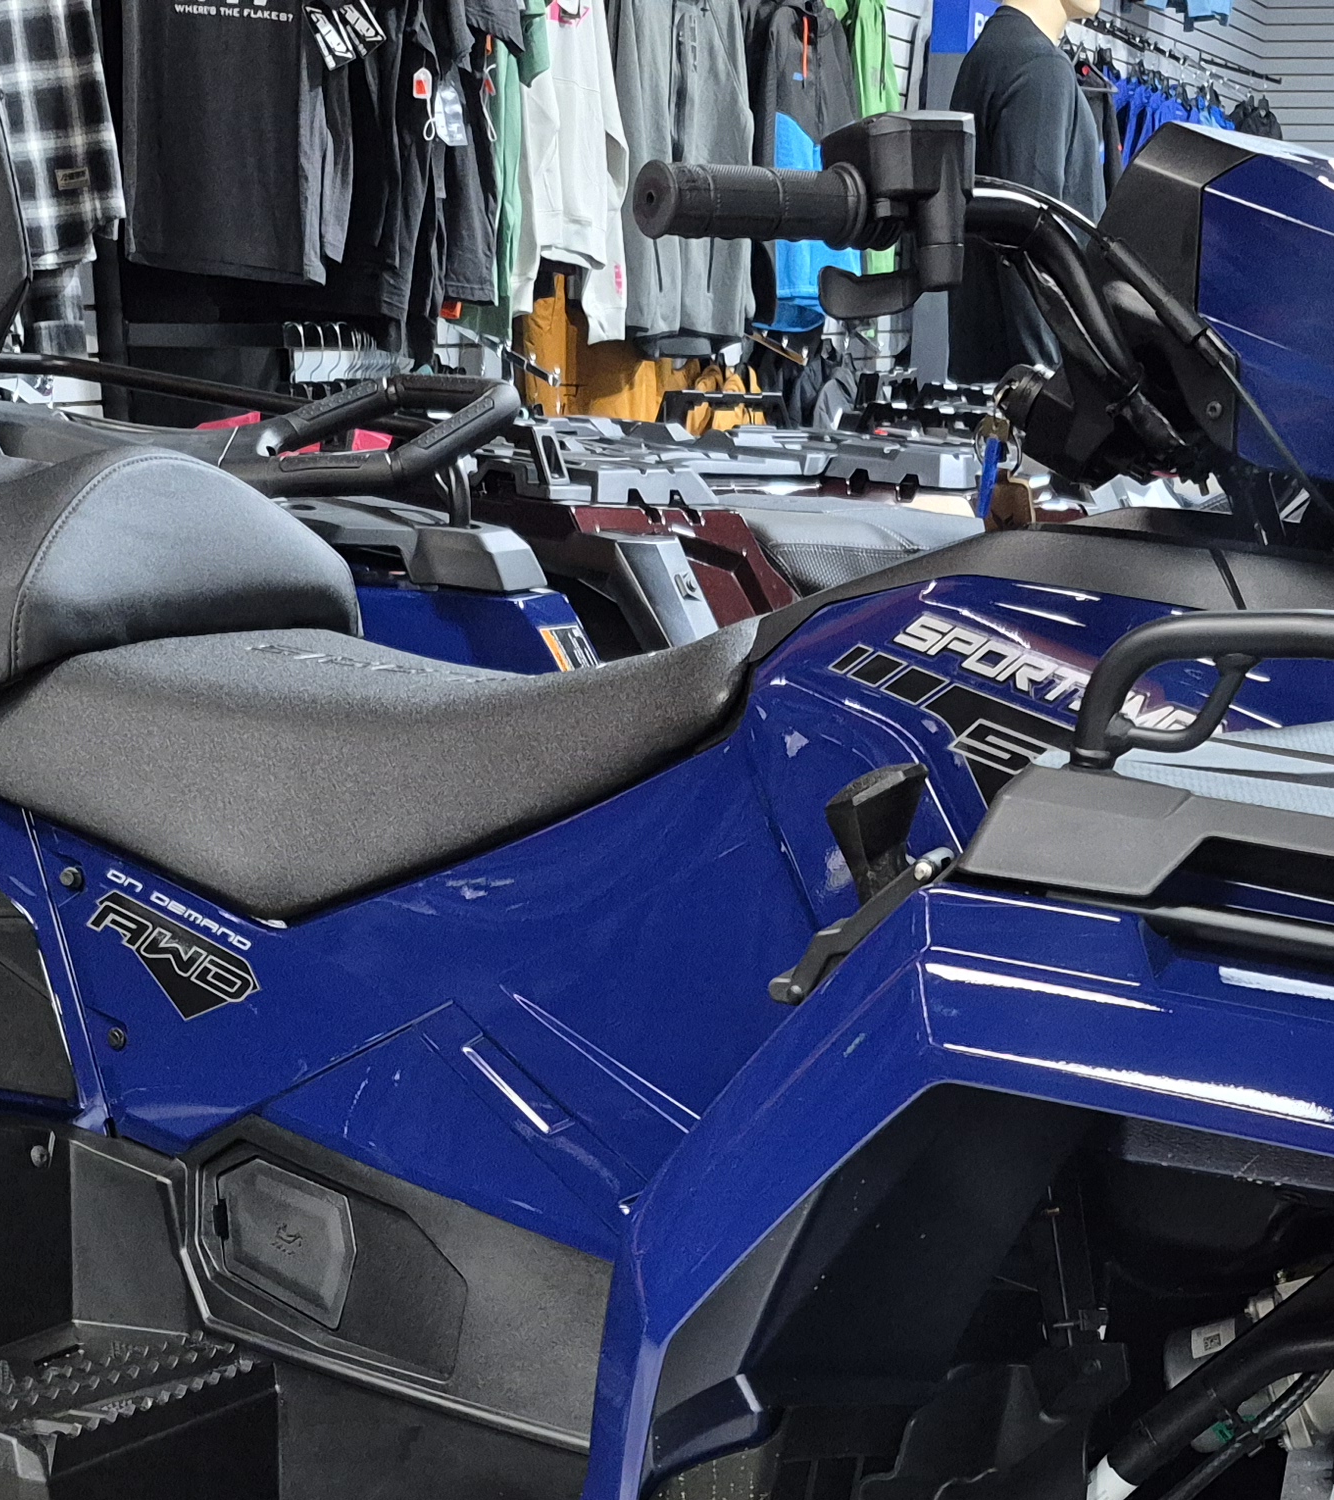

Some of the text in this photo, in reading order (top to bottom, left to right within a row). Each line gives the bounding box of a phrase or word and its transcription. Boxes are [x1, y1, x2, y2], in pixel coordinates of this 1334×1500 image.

[174, 4, 294, 22] WHERE'S THE FLAKES?
[106, 868, 252, 950] ON DEMAND
[86, 901, 254, 1003] AWD
